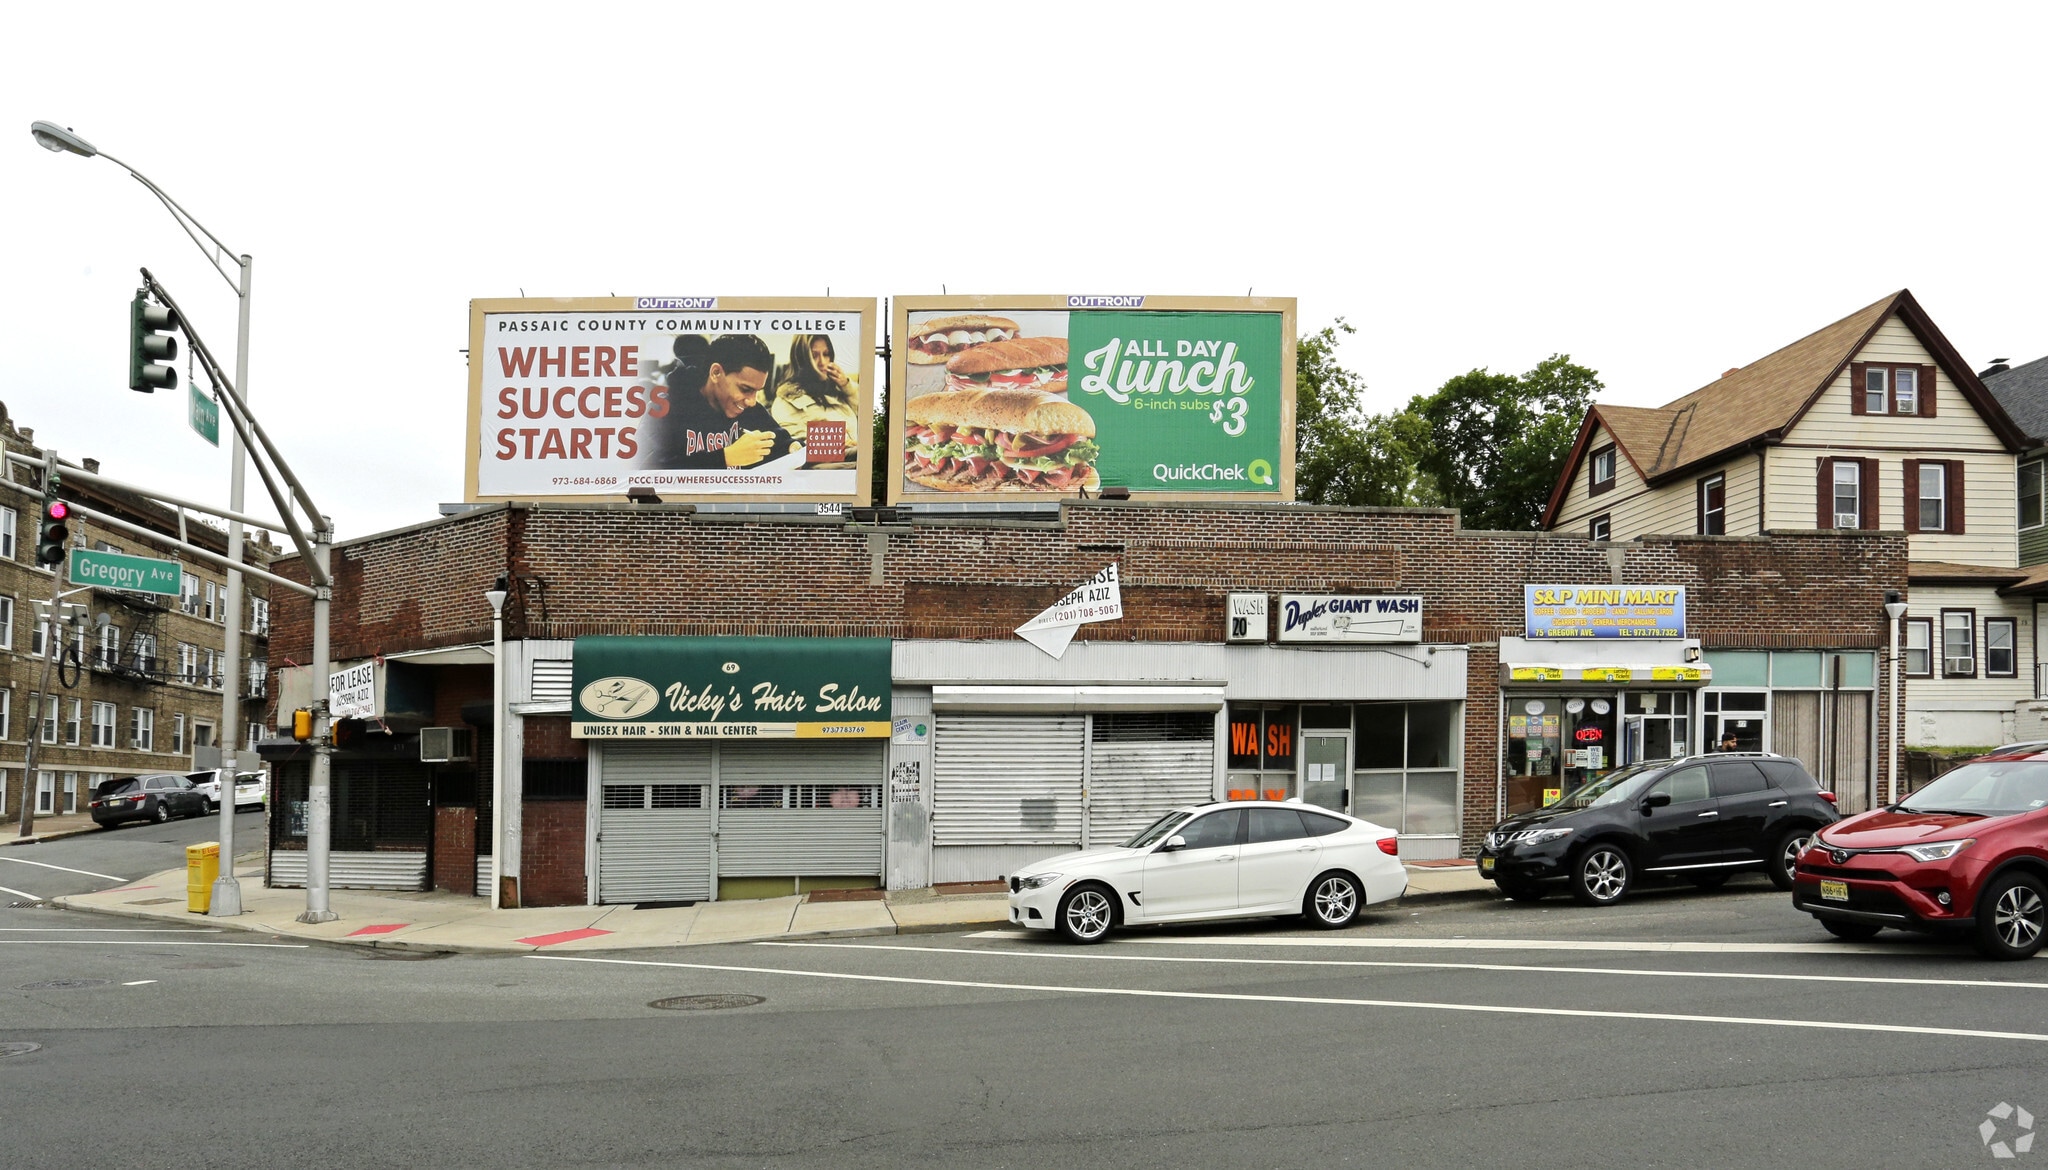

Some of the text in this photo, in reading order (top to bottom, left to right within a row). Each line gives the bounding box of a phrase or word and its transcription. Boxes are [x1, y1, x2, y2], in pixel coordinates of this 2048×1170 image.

[639, 298, 712, 308] OUTFRONT
[1069, 296, 1142, 307] OUTFRONT
[499, 319, 846, 332] PASSAIC COUNTY COMMUNITY COLLEGE
[1124, 340, 1222, 357] ALL DAY
[498, 345, 639, 378] WHERE
[1081, 337, 1254, 403] Lunch
[496, 386, 671, 419] SUCCESS
[1134, 398, 1210, 410] 6-inch subs
[1209, 396, 1249, 437] $3
[495, 427, 638, 460] STARTS
[552, 477, 618, 485] 973-684-6868
[1152, 463, 1245, 482] QuickChek
[818, 503, 841, 514] 3544
[80, 558, 173, 588] Gregory Ave
[1089, 587, 1111, 602] AZIZ
[1533, 589, 1678, 606] S&P MINI MART
[1054, 609, 1077, 622] (201)
[1079, 604, 1119, 618] 708-5067
[1284, 599, 1329, 633] Duplex
[1328, 599, 1372, 613] GIANT
[1376, 599, 1419, 613] WASH
[1232, 617, 1248, 637] 20
[1535, 629, 1595, 637] 75 GREGORY AVE.
[1633, 629, 1678, 637] 973.779.7322
[331, 666, 372, 693] FOR LEASE
[665, 681, 882, 722] Vicky's Hair Salon
[583, 725, 618, 735] UNISEX
[622, 725, 647, 735] HAIR
[658, 725, 681, 735] SKIN
[684, 725, 692, 735] &
[696, 725, 718, 735] NAIL
[722, 725, 757, 735] CENTER
[1575, 730, 1603, 741] OPEN
